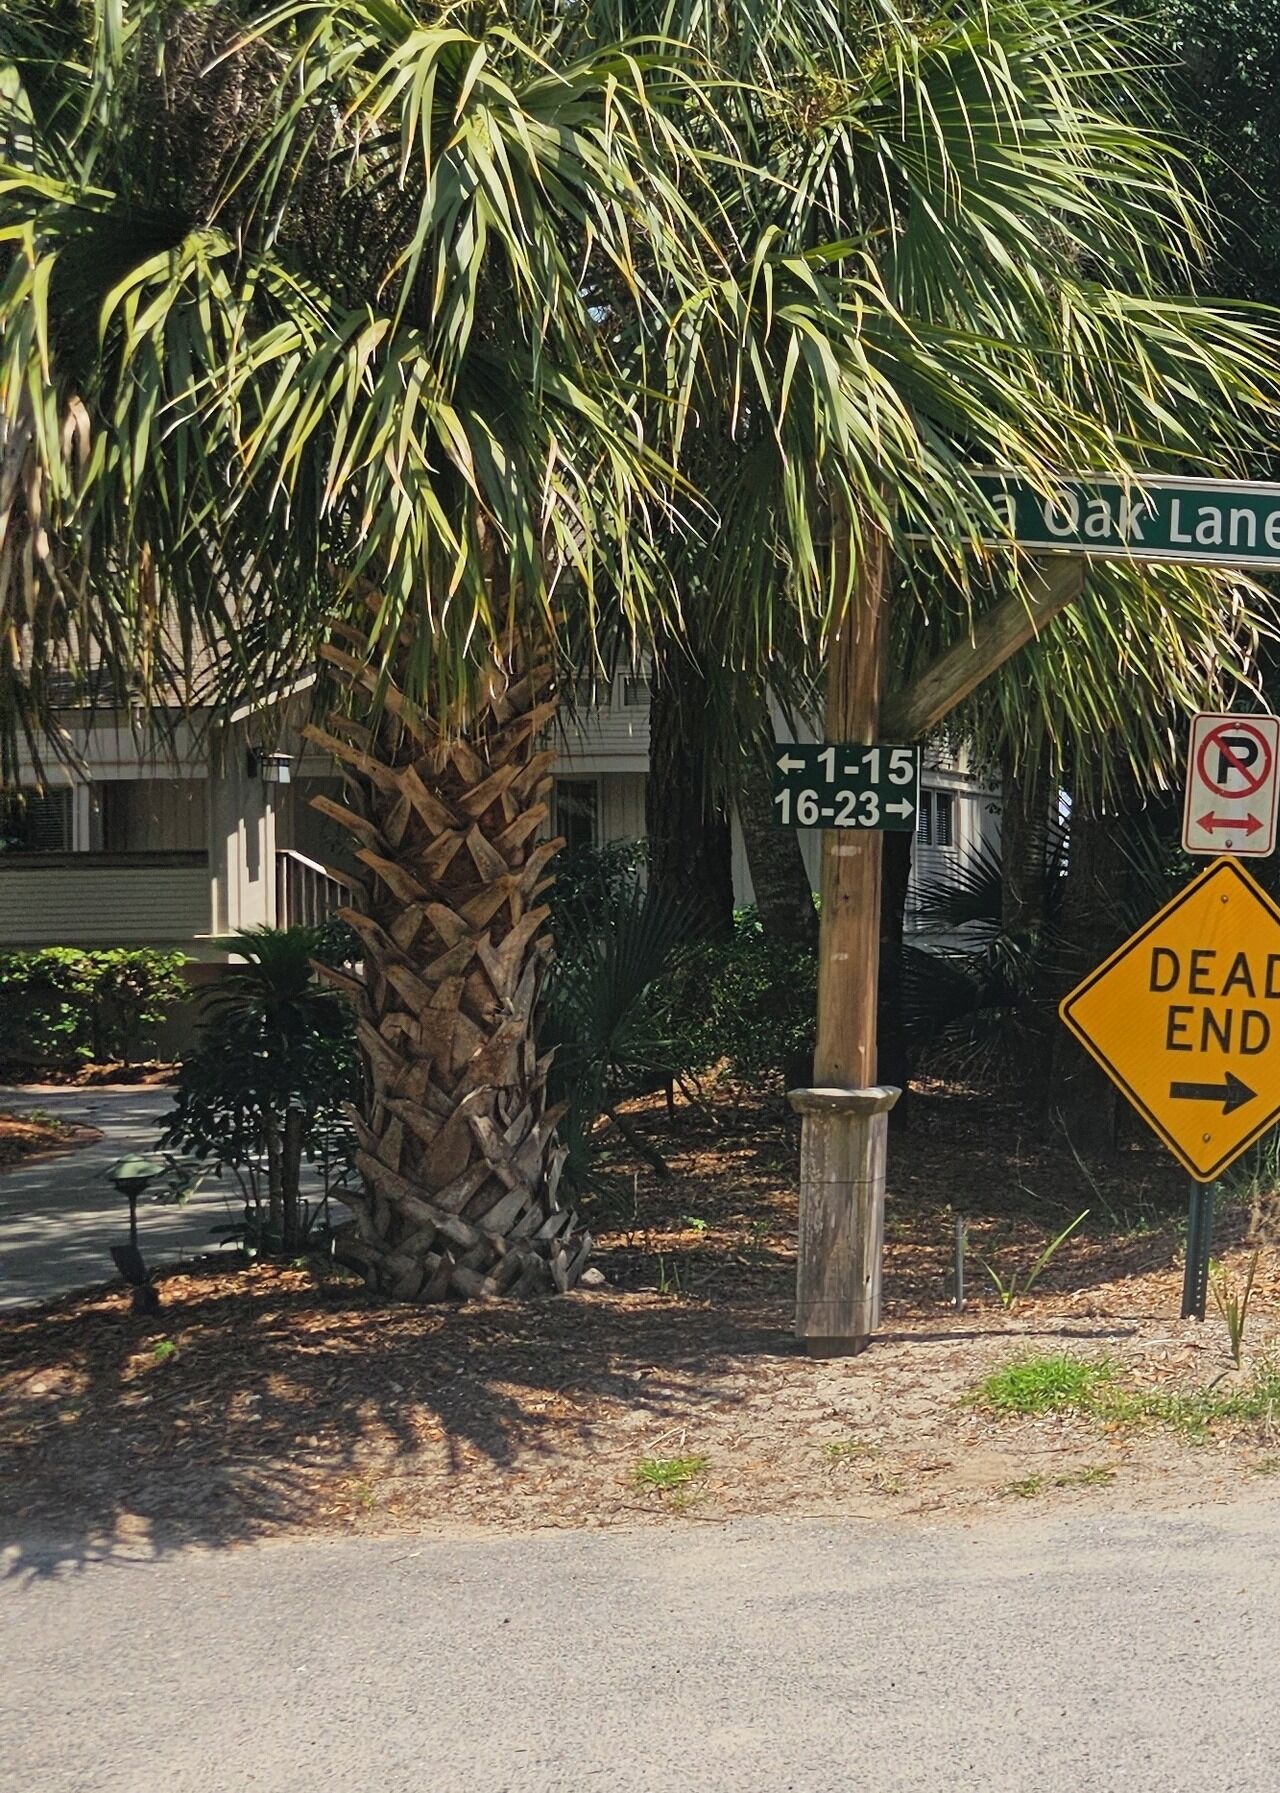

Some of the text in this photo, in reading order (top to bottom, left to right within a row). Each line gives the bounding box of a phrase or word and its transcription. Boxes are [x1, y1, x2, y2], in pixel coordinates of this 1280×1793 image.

[1044, 489, 1145, 540] Oak
[817, 747, 914, 785] 1-15
[774, 788, 880, 827] 16-23
[1165, 1005, 1271, 1055] END
